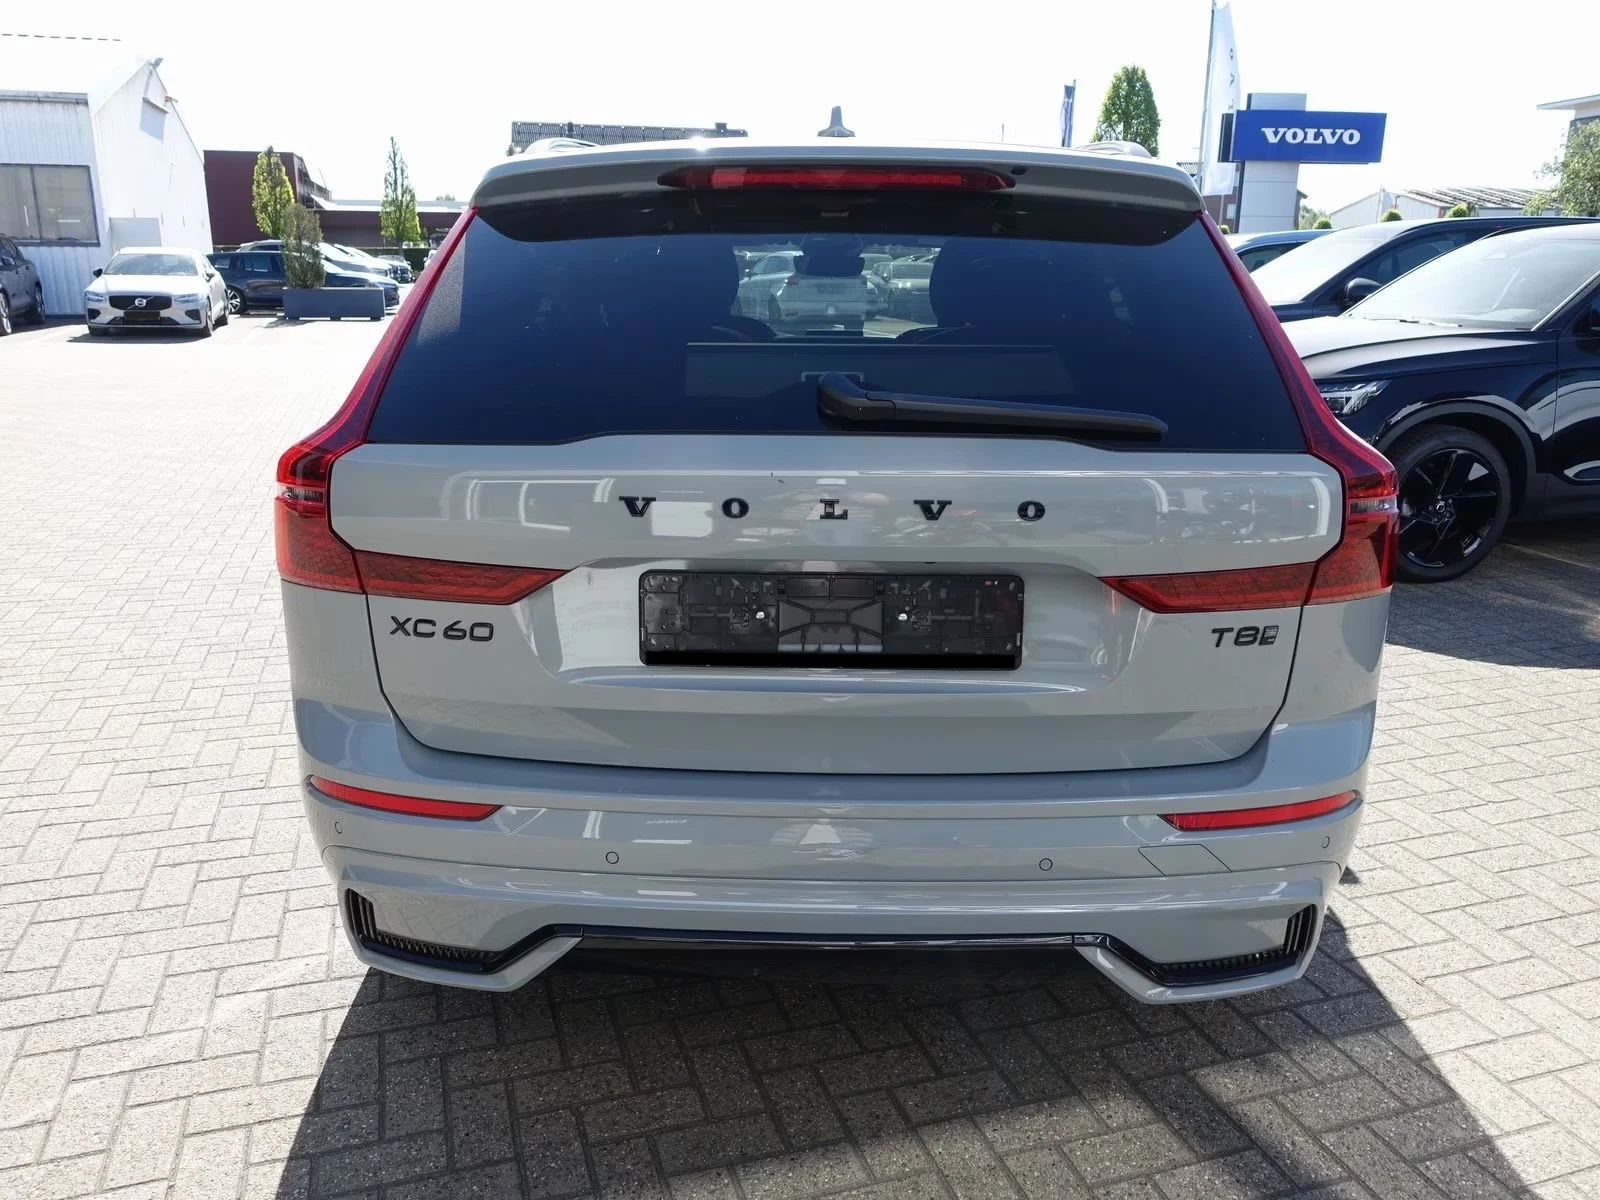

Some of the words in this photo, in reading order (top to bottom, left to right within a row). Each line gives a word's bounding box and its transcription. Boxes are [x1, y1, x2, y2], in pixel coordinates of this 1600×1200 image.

[1261, 128, 1360, 144] VOLVO
[619, 496, 1046, 521] VOLVO
[389, 615, 494, 641] XC60
